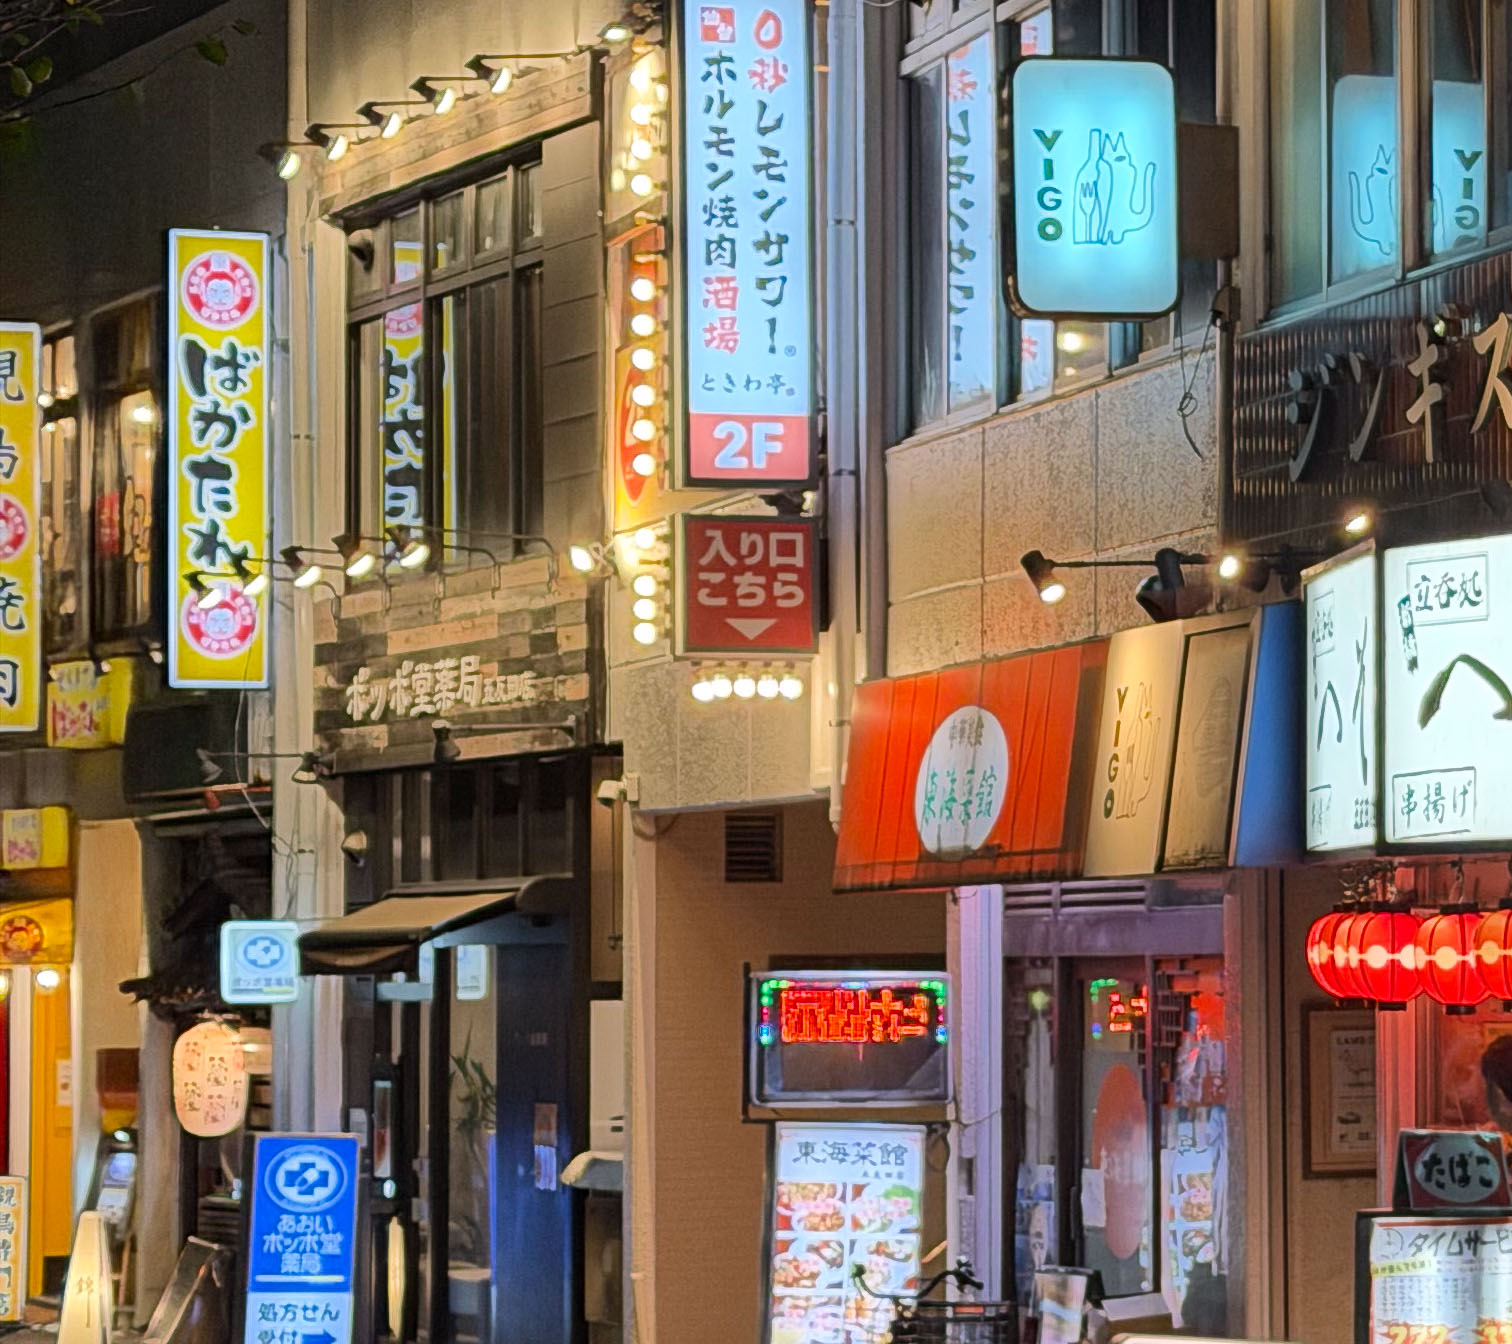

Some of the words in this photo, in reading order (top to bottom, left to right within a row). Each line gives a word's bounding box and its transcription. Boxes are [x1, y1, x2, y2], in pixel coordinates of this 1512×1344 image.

[700, 49, 740, 355] ホルモン焼肉酒場
[1033, 128, 1064, 242] VIGO
[181, 339, 258, 568] ばかたれ
[712, 419, 785, 470] 2F
[698, 529, 804, 568] 入り口
[697, 571, 805, 608] こちら
[1103, 685, 1129, 820] VIGO
[1400, 779, 1473, 829] 串揚げ
[792, 1139, 908, 1167] 東海菜館
[1422, 1150, 1494, 1189] たばこ
[277, 1214, 334, 1234] あおい
[258, 1302, 341, 1323] 処方せん
